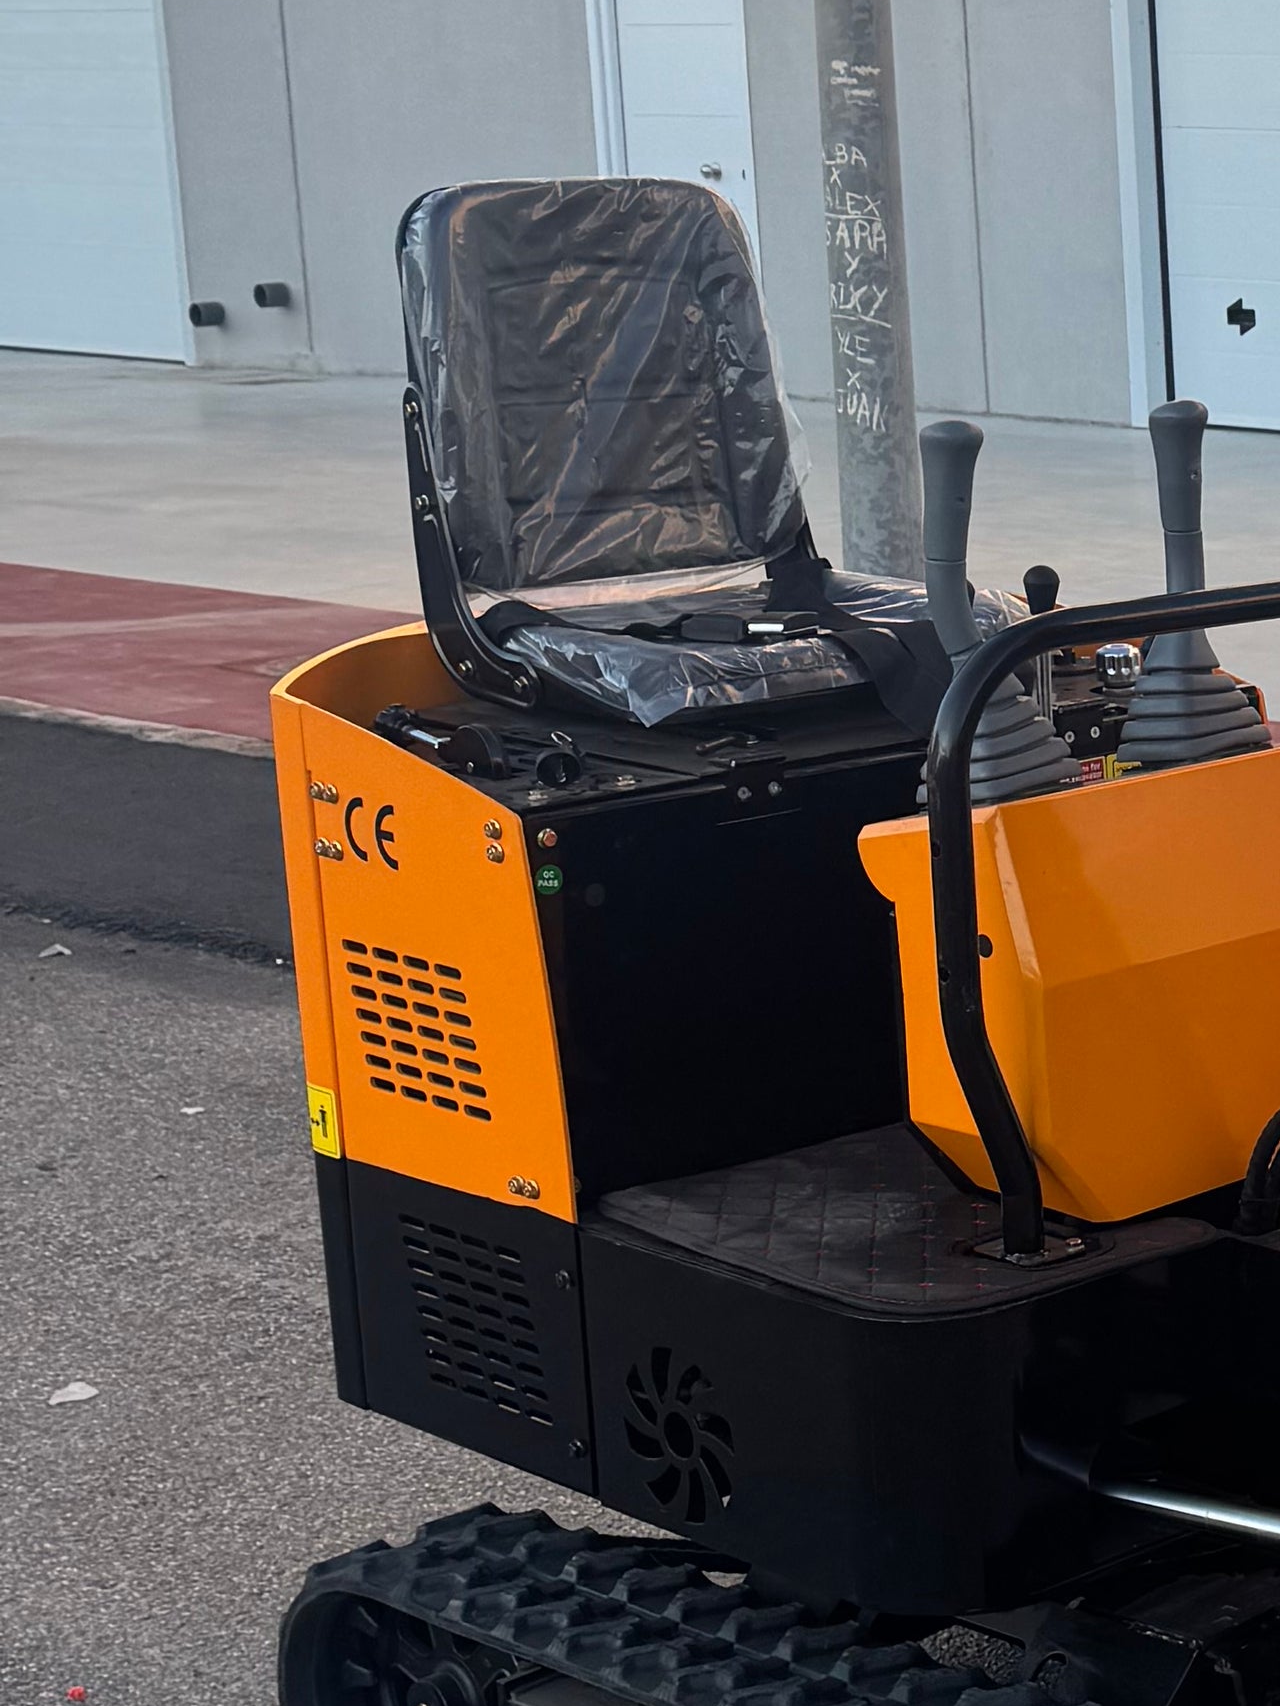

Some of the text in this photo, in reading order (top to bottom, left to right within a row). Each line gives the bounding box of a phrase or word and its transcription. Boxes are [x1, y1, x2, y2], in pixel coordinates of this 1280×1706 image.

[826, 219, 887, 260] SARA
[844, 251, 864, 278] Y
[345, 797, 399, 870] CE
[537, 879, 559, 888] PASS
[543, 870, 555, 879] QC
